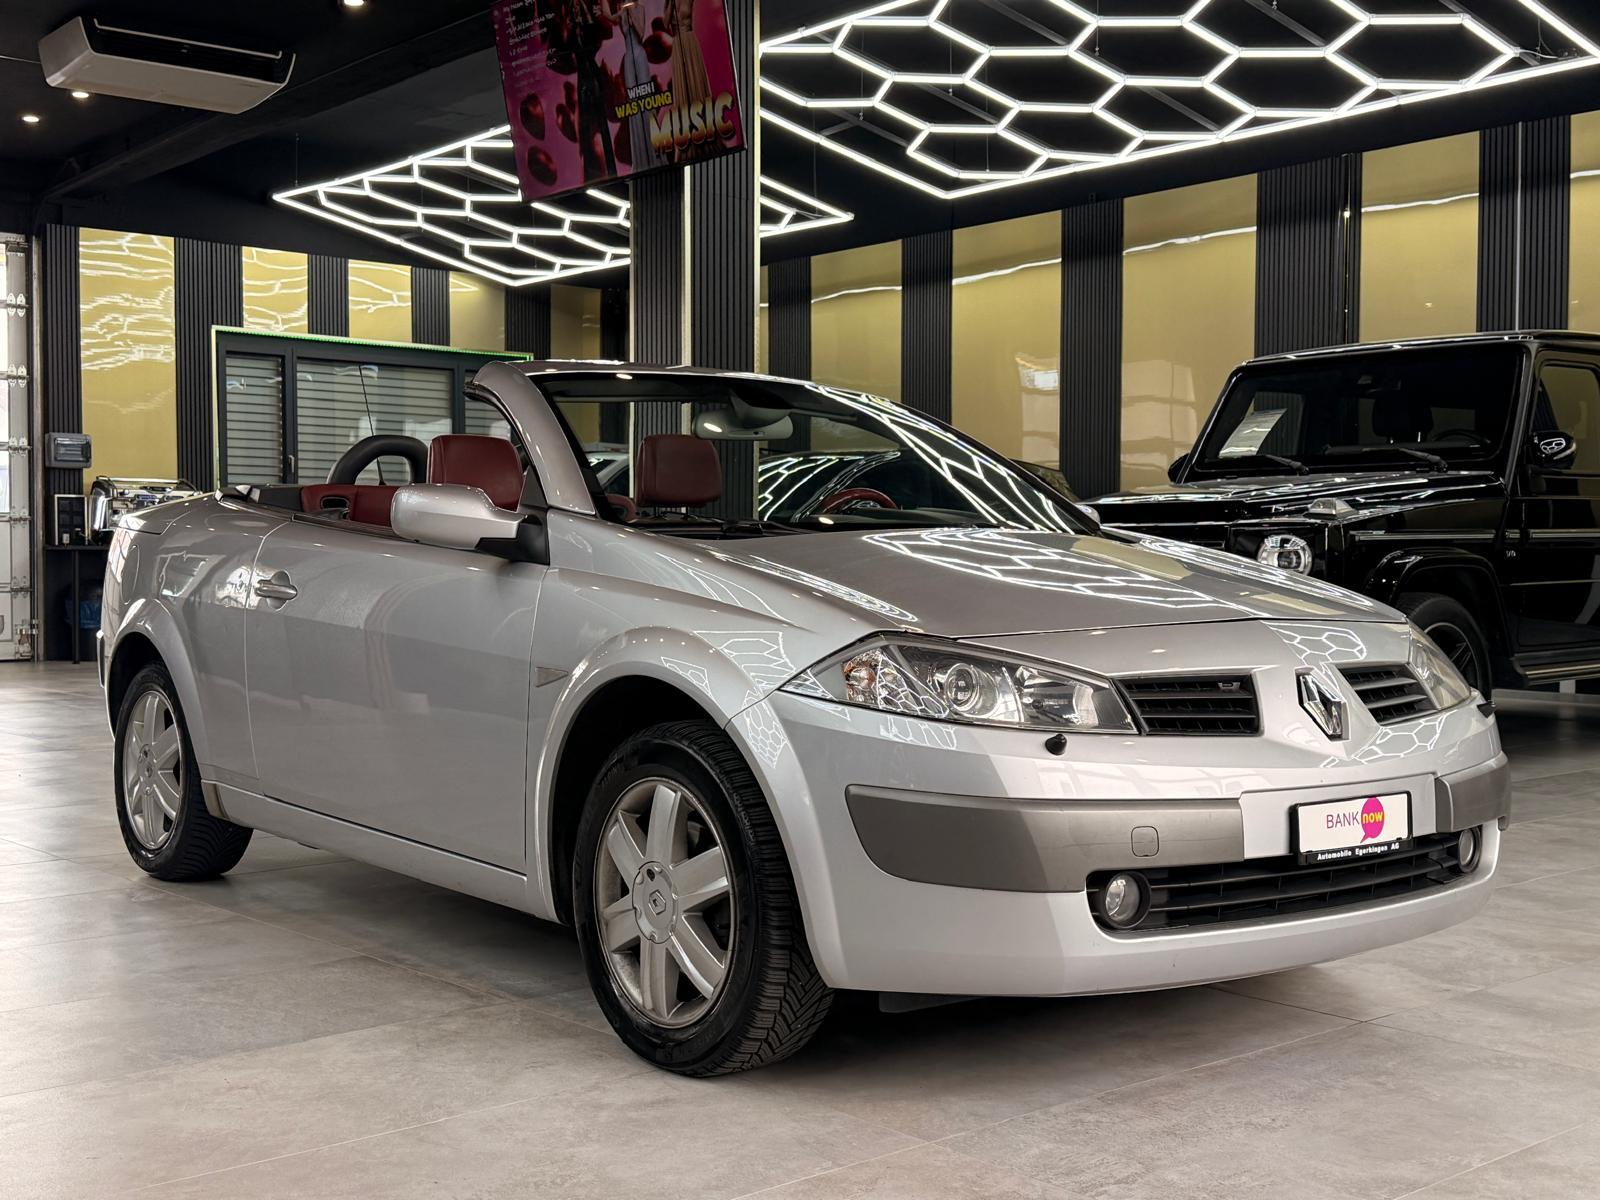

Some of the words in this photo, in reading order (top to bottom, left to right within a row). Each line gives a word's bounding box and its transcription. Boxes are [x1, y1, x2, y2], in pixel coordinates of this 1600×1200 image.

[627, 83, 650, 99] WHEN
[615, 102, 638, 119] WAS
[638, 91, 672, 111] YOUNG
[650, 91, 734, 152] MUSIC
[1326, 811, 1360, 829] BANK
[1362, 812, 1384, 824] now
[1317, 850, 1352, 861] Automobile
[1355, 845, 1388, 856] Egerkingen
[1391, 842, 1399, 850] AG
